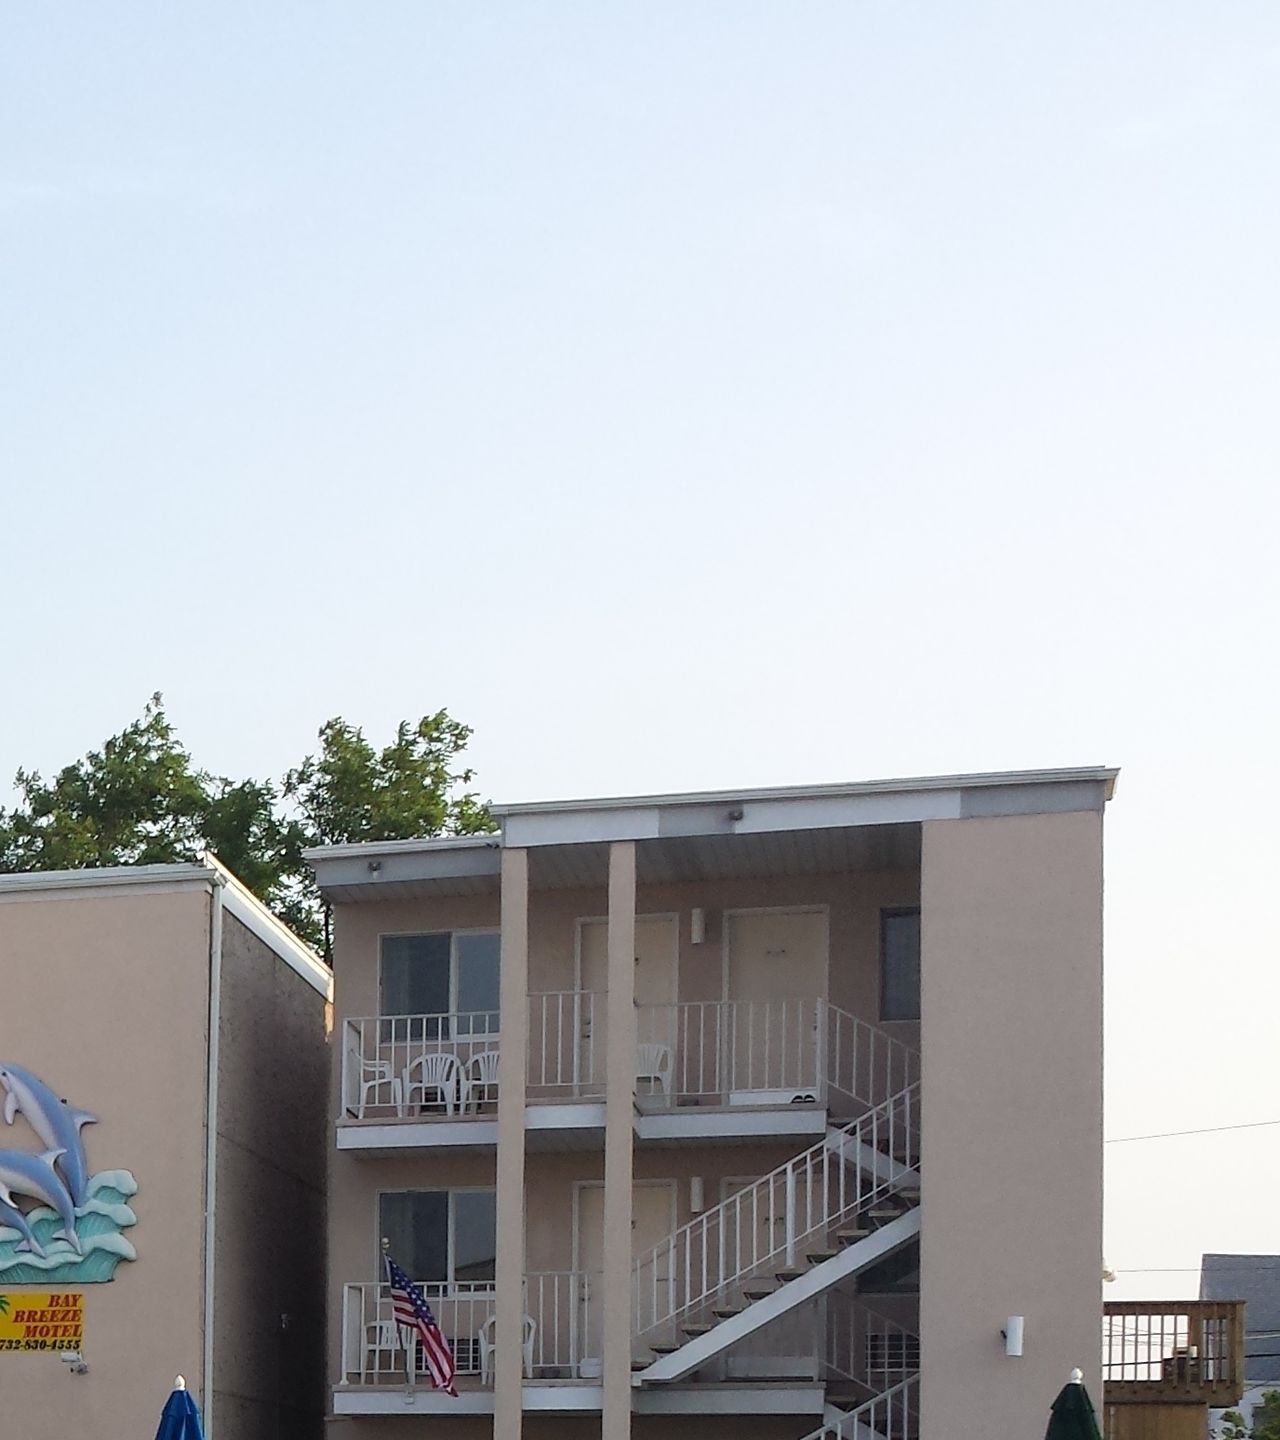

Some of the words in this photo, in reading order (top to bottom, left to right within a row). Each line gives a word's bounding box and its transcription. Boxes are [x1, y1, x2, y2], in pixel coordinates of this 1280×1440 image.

[48, 1294, 83, 1308] BAY
[13, 1309, 83, 1323] BREEZE
[23, 1324, 82, 1338] MOTEL
[0, 1339, 81, 1351] 732-830-4555
